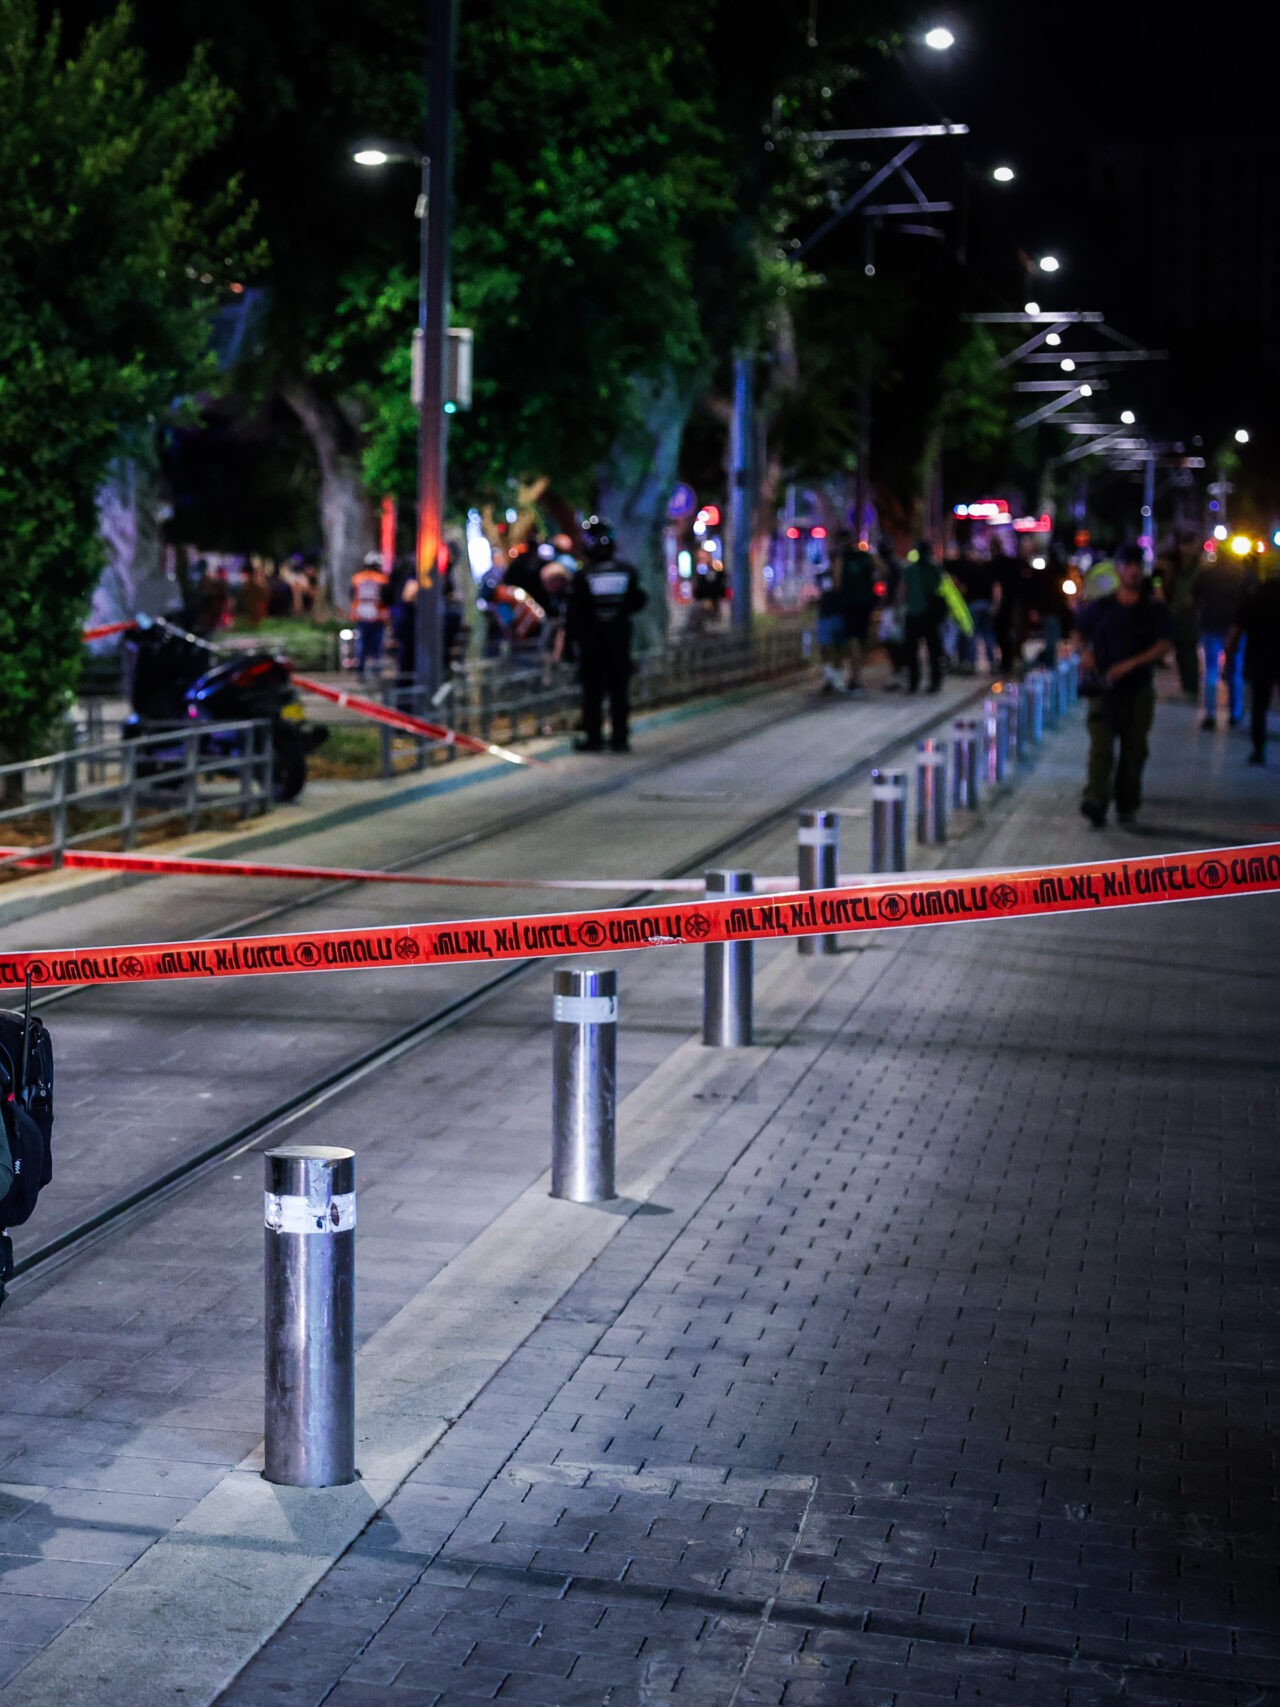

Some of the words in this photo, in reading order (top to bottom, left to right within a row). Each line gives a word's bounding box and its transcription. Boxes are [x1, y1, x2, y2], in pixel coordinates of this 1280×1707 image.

[52, 957, 119, 981] משטרת
[157, 950, 215, 975] ישראל
[216, 944, 240, 970] אין
[245, 946, 293, 968] מעבר
[324, 938, 392, 963] משטרת
[434, 930, 494, 957] ישראל
[496, 922, 520, 951] אין
[525, 924, 580, 949] מעבר
[610, 916, 682, 943] משטרת
[725, 905, 790, 931] ישראל
[792, 896, 816, 927] אין
[822, 897, 876, 925] מעבר
[911, 885, 987, 918] משטרת
[1034, 875, 1101, 905] ישראל
[1103, 865, 1129, 896] אין
[1135, 864, 1195, 893] מעבר
[1231, 854, 1280, 885] משט
